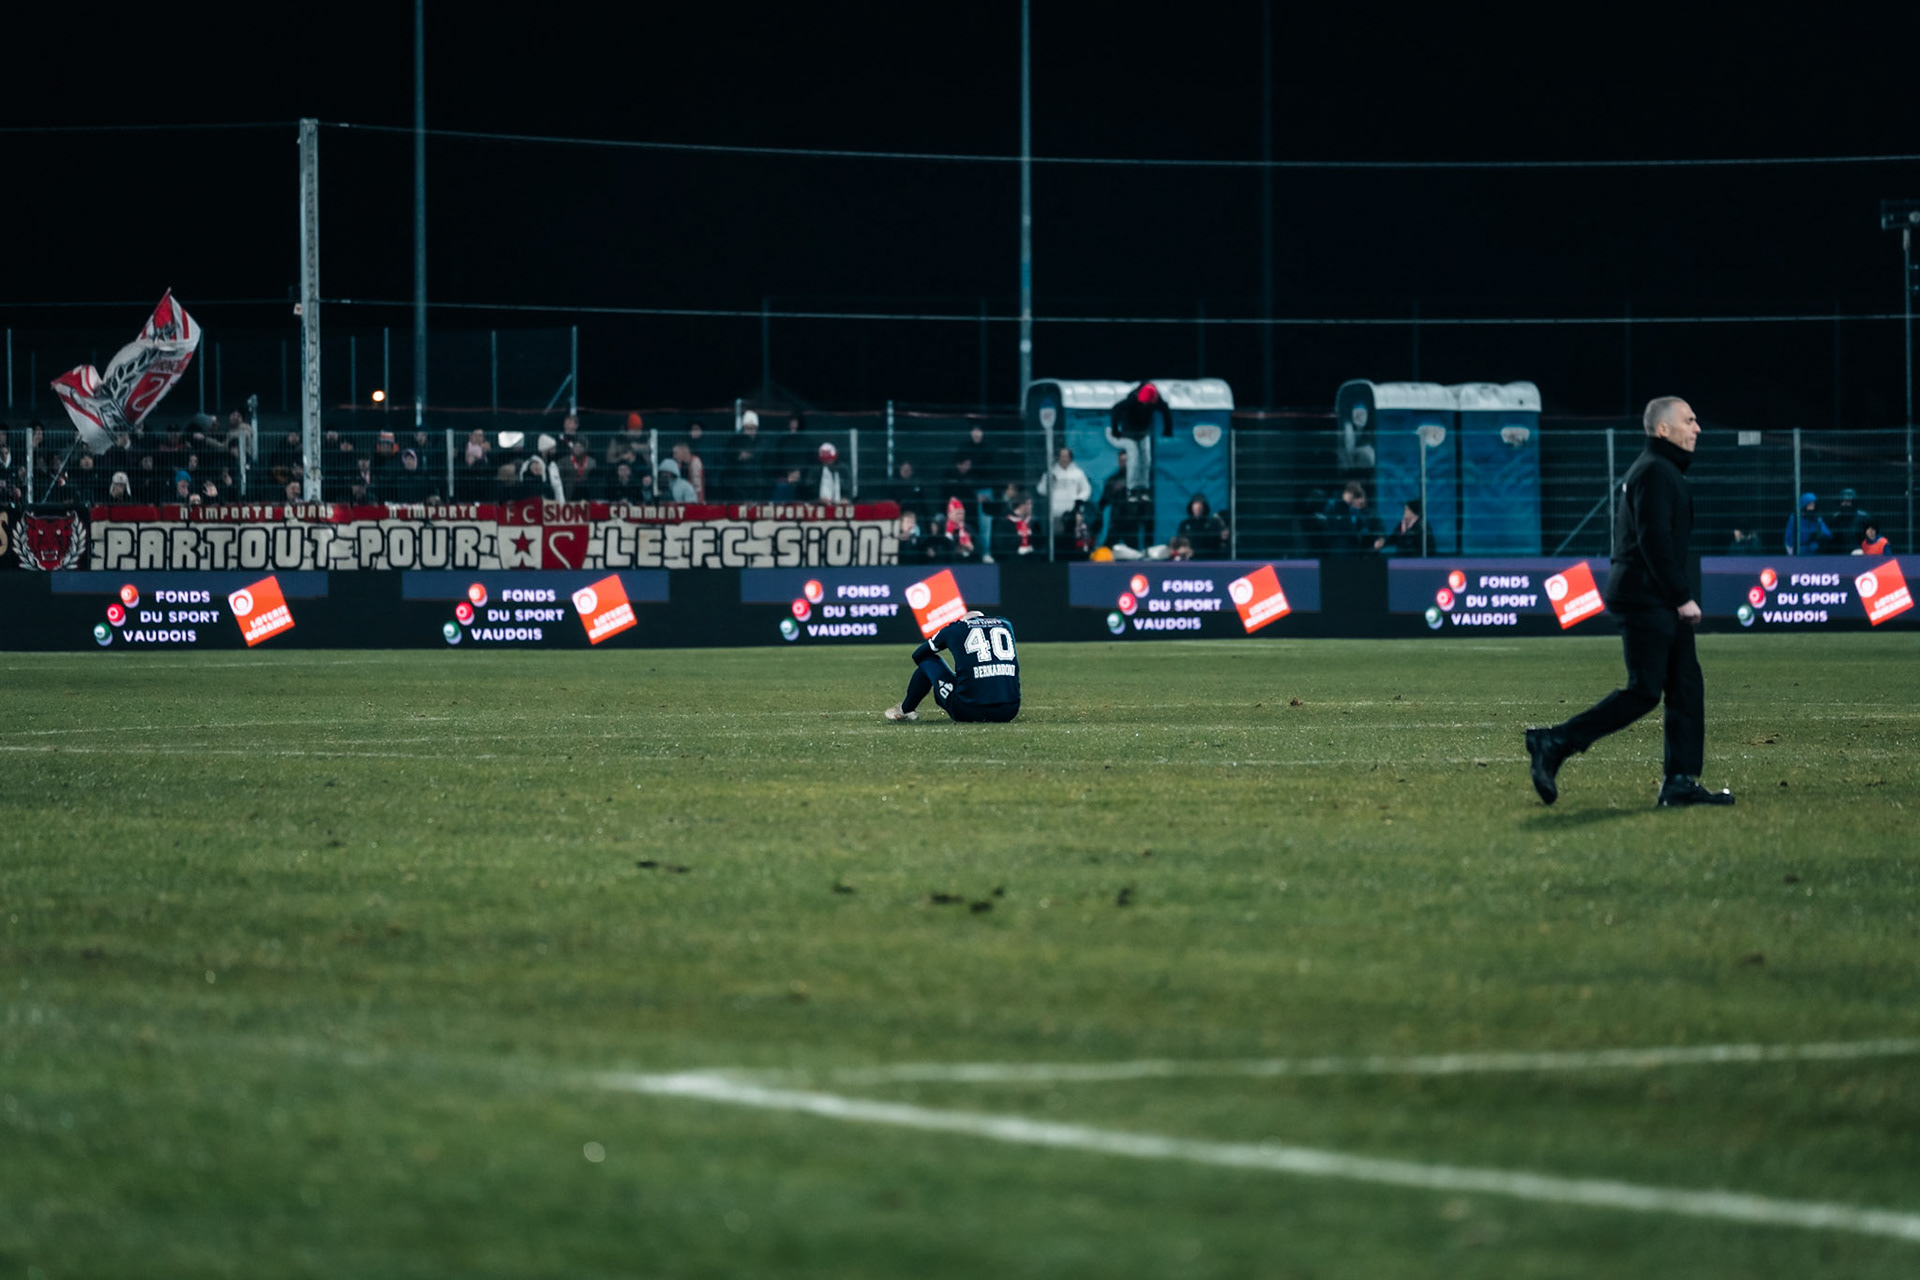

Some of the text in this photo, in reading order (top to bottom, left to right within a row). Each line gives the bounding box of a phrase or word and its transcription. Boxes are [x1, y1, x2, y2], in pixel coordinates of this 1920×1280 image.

[545, 503, 588, 522] SION
[104, 527, 337, 570] PARTOUT
[358, 526, 481, 570] POUR
[604, 526, 664, 568] LE
[690, 526, 749, 568] FC
[1162, 580, 1214, 593] FONDS
[1479, 576, 1529, 589] FONDS
[1790, 574, 1840, 586] FONDS
[155, 591, 211, 603] FONDS
[502, 589, 556, 602] FONDS
[837, 585, 891, 598] FONDS
[1466, 594, 1538, 608] DU SPORT
[1777, 592, 1848, 605] DU SPORT
[823, 604, 899, 618] DU SPORT
[1148, 599, 1222, 612] DU SPORT
[140, 611, 220, 623] DU SPORT
[487, 609, 565, 622] DU SPORT
[1451, 613, 1518, 626] VAUDOIS
[1762, 610, 1828, 623] VAUDOIS
[807, 623, 878, 636] VAUDOIS
[1133, 617, 1202, 630] VAUDOIS
[123, 630, 197, 642] VAUDOIS
[471, 628, 543, 641] VAUDOIS
[963, 626, 1016, 662] 40
